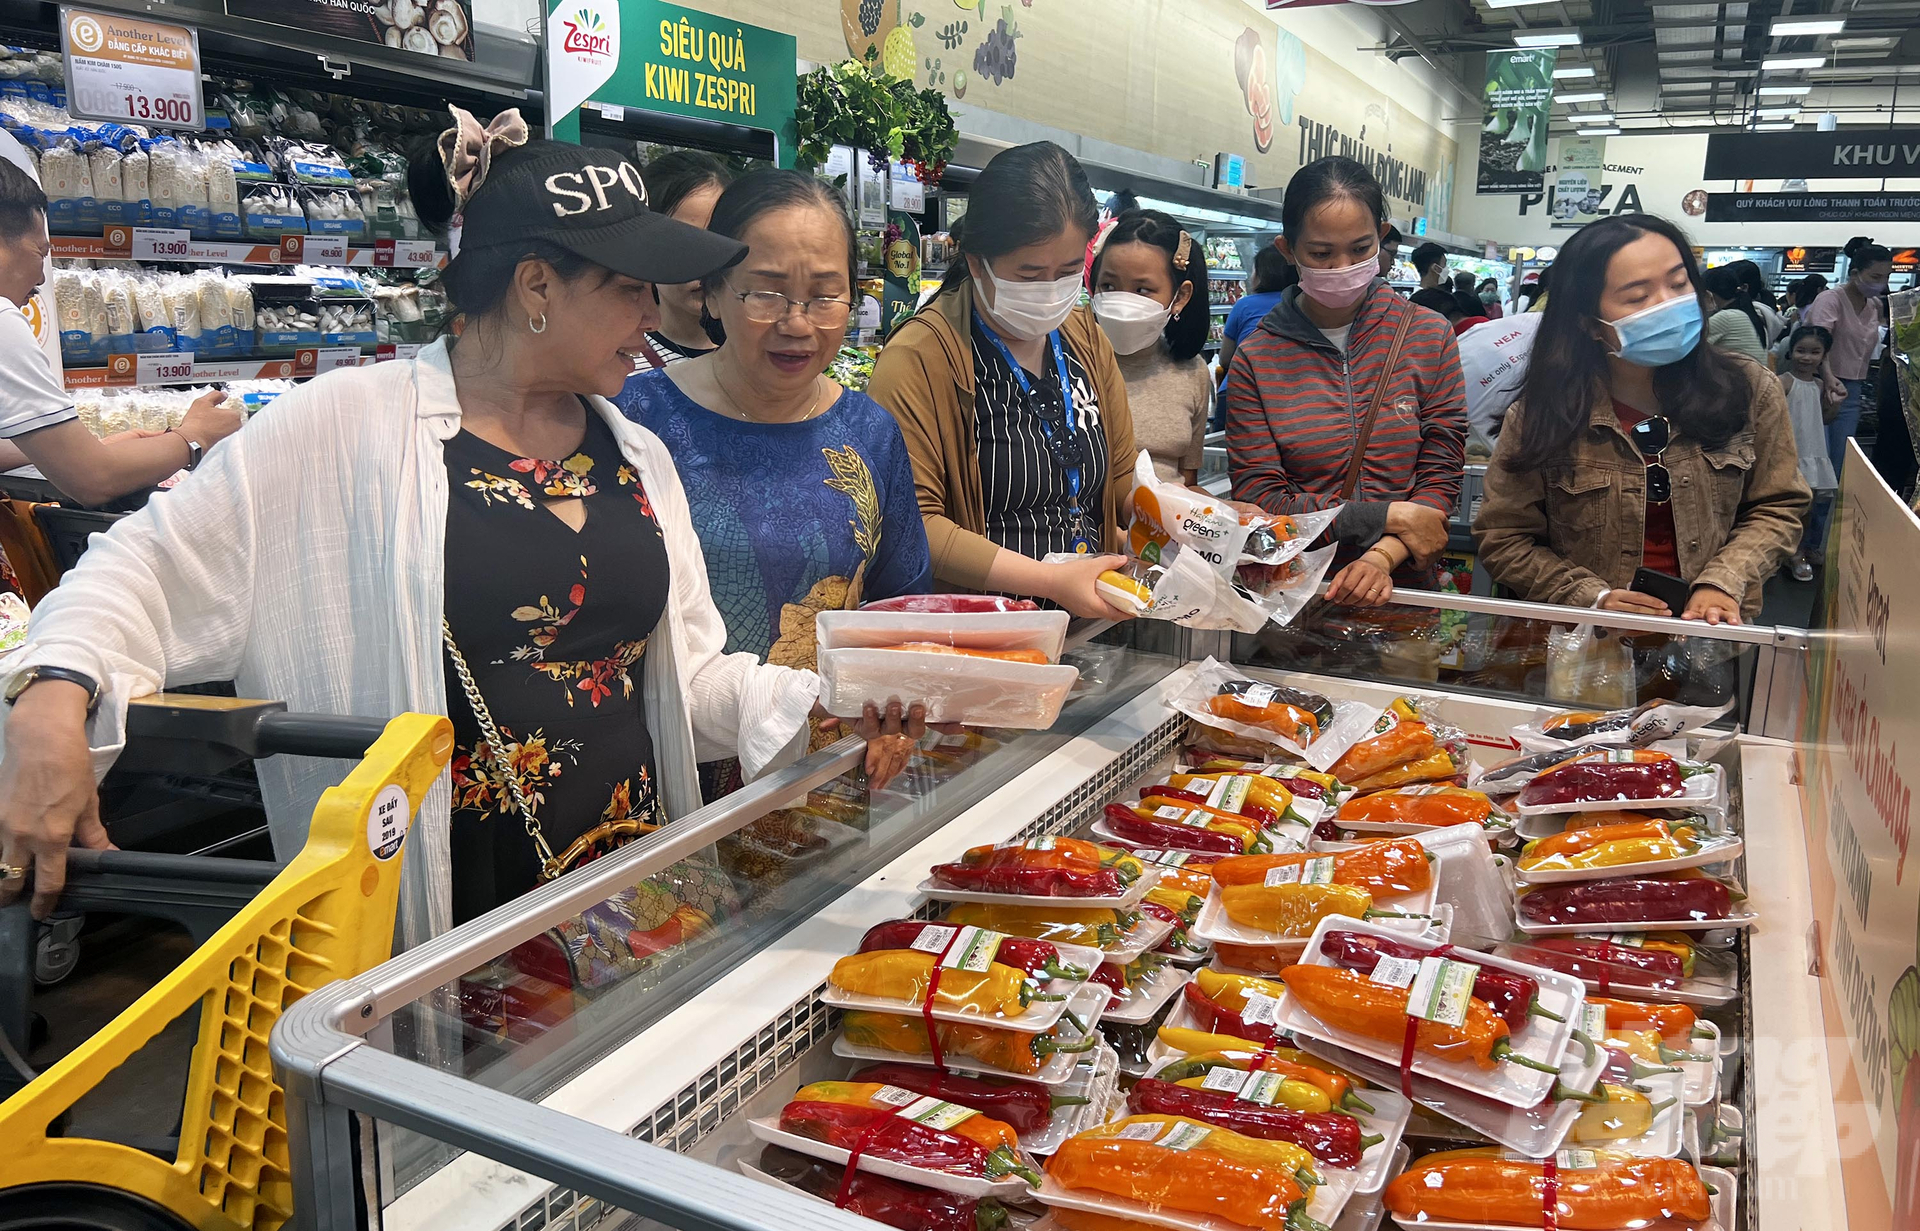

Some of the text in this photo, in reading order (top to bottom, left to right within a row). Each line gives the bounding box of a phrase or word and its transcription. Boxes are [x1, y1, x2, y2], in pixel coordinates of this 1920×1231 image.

[350, 2, 375, 15] QUỐC
[107, 25, 187, 46] Another Level
[563, 21, 612, 57] Zespri
[148, 45, 170, 57] KHÁC
[660, 16, 746, 72] SIÊU QUẢ
[645, 62, 756, 116] KIWI ZESPRI
[125, 94, 191, 123] 13.900
[1833, 145, 1896, 165] KHU
[1603, 164, 1644, 175] ACEMENT
[544, 161, 649, 217] SPO
[1403, 164, 1426, 212] LẠNH
[1519, 184, 1643, 216] PIZA
[1736, 196, 1920, 208] QUÝ KHÁCH VUI LÒNG THANH TOÁN TRƯỚC
[50, 243, 88, 253] Another
[151, 242, 187, 255] 13.900
[206, 249, 228, 258] Level
[321, 249, 343, 258] 49.900
[890, 249, 914, 260] Global
[407, 252, 433, 263] 43.900
[1493, 331, 1522, 347] NEM
[335, 358, 356, 367] 49.900
[156, 365, 191, 378] 13.900
[218, 368, 240, 378] Level
[1480, 373, 1495, 387] Not
[1495, 362, 1511, 376] only
[65, 375, 102, 384] Another
[1182, 518, 1221, 539] greens
[1867, 563, 1890, 666] emart
[1866, 715, 1911, 887] Chuông
[378, 804, 386, 816] XE
[382, 815, 394, 828] SAU
[381, 827, 396, 842] 2019
[380, 840, 399, 856] emart
[1841, 812, 1873, 932] VITAMIN
[1834, 904, 1855, 1003] DINH
